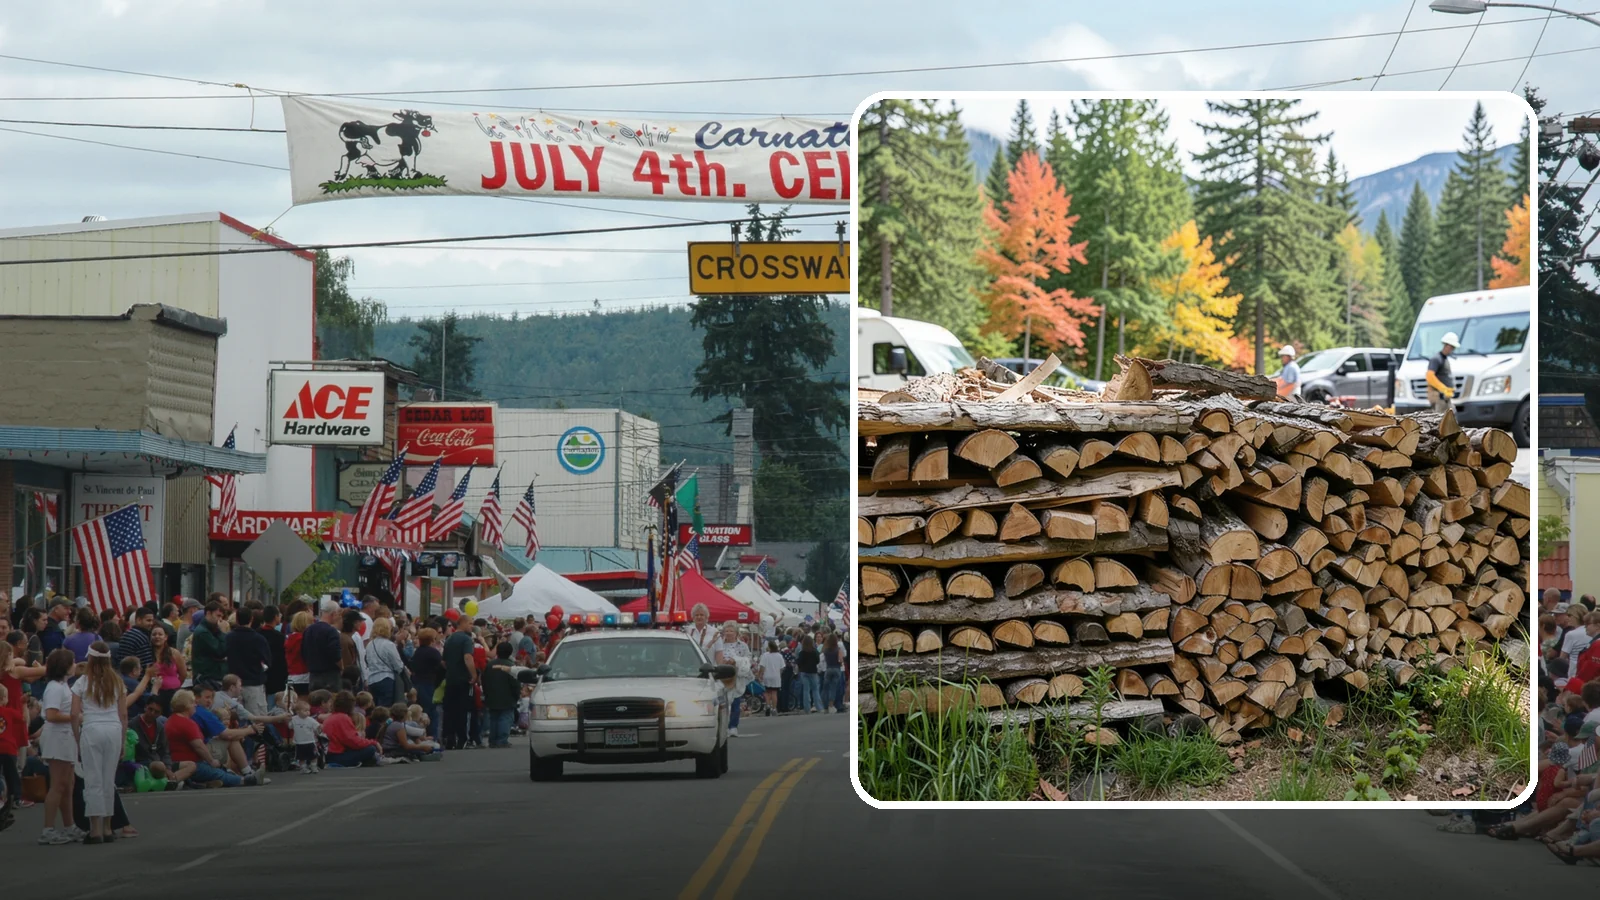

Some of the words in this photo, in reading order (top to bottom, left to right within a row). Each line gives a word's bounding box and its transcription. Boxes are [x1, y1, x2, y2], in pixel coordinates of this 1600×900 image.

[480, 140, 605, 193] JULY
[632, 150, 747, 198] 4th.
[697, 254, 850, 280] CROSSWA
[283, 380, 374, 420] ACE
[405, 409, 453, 422] CEDAR
[460, 409, 485, 421] LOG
[283, 421, 371, 437] Hardware
[416, 428, 477, 447] Coca-Cola
[353, 467, 384, 479] Simpl
[83, 484, 93, 494] St.
[95, 484, 124, 495] Vincent
[126, 485, 136, 495] de
[137, 485, 155, 495] Paul
[80, 503, 154, 522] THT
[212, 516, 331, 535] HARDARE
[688, 526, 741, 536] CRNATION
[699, 535, 730, 543] GLASS
